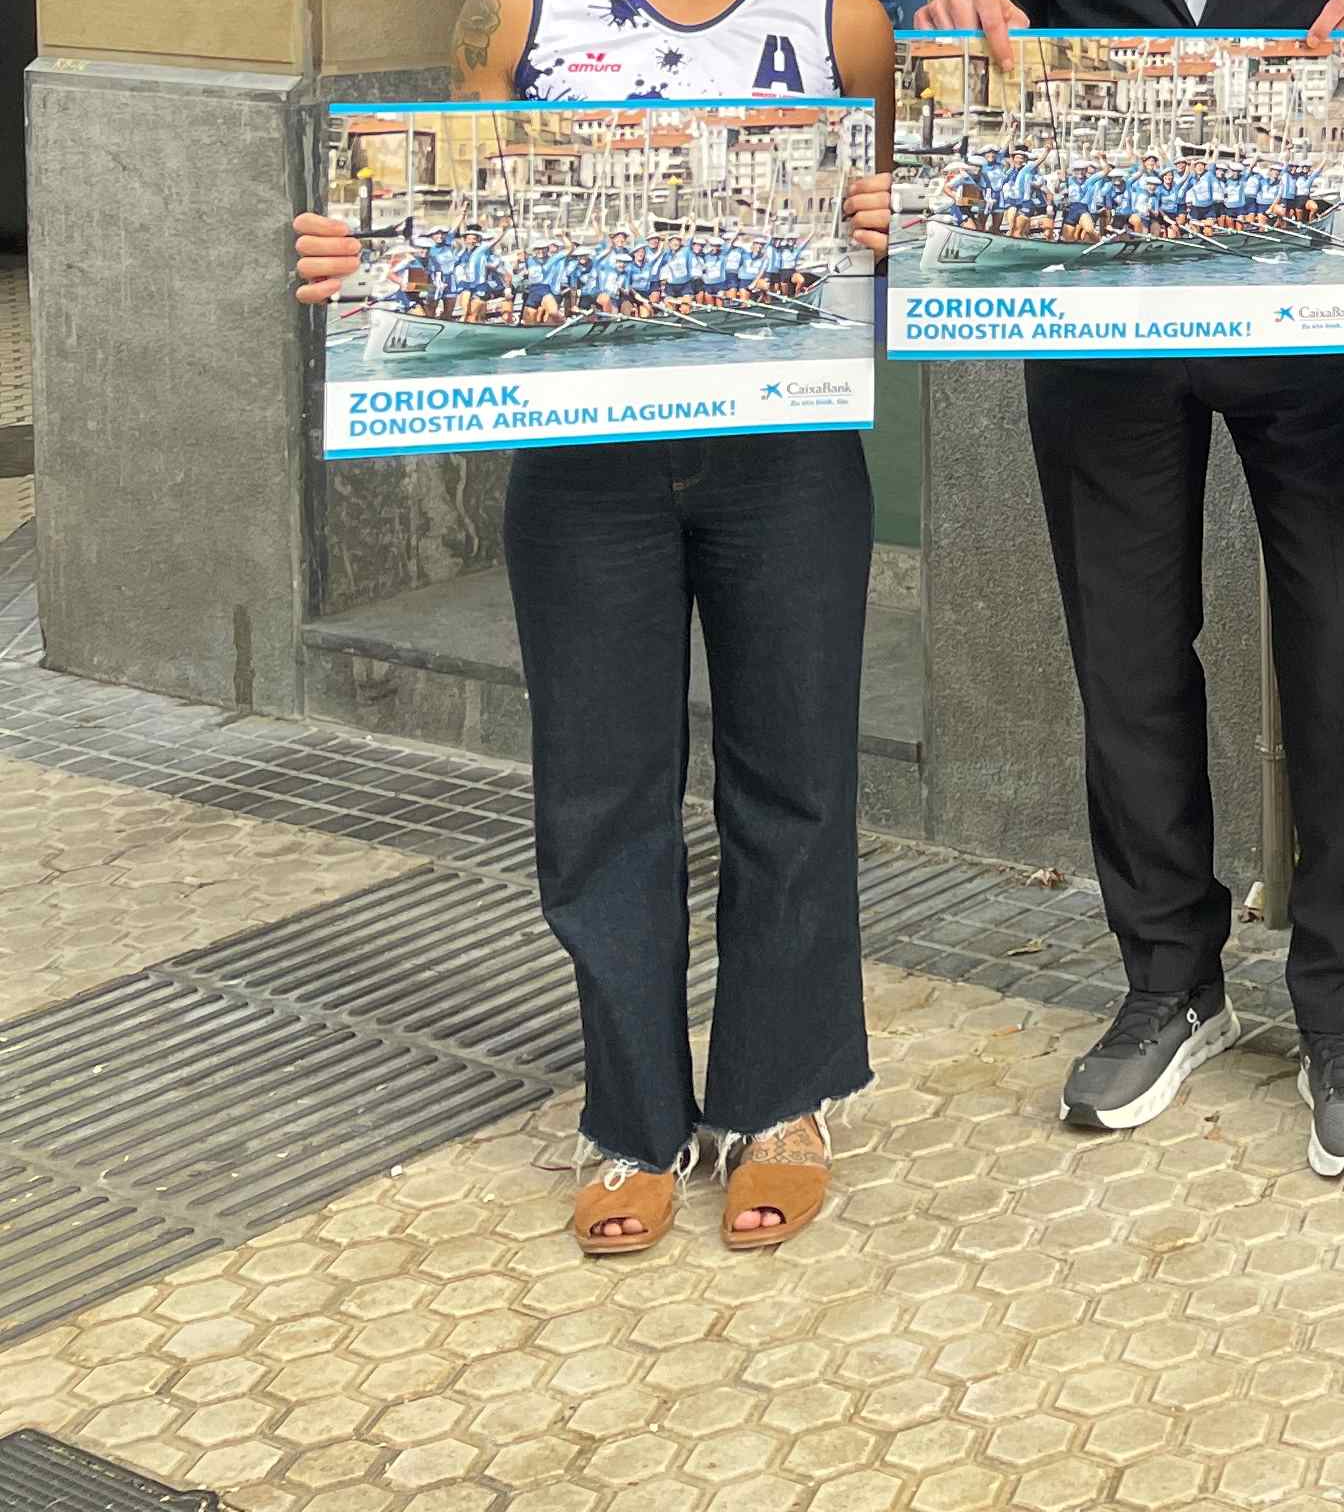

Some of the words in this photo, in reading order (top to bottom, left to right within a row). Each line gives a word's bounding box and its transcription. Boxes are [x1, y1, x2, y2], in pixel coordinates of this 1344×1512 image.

[568, 63, 621, 72] amura
[905, 297, 1064, 319] ZORIONAK,
[906, 323, 1024, 340] DONOSTIA
[1032, 322, 1127, 339] ARRAUN
[1135, 322, 1251, 338] LAGUNAK!
[786, 381, 852, 394] CaixaBank
[351, 385, 528, 414] ZORIONAK,
[351, 415, 483, 437] DONOSTIA
[493, 408, 598, 428] ARRAUN
[608, 402, 735, 422] LAGUNAK!
